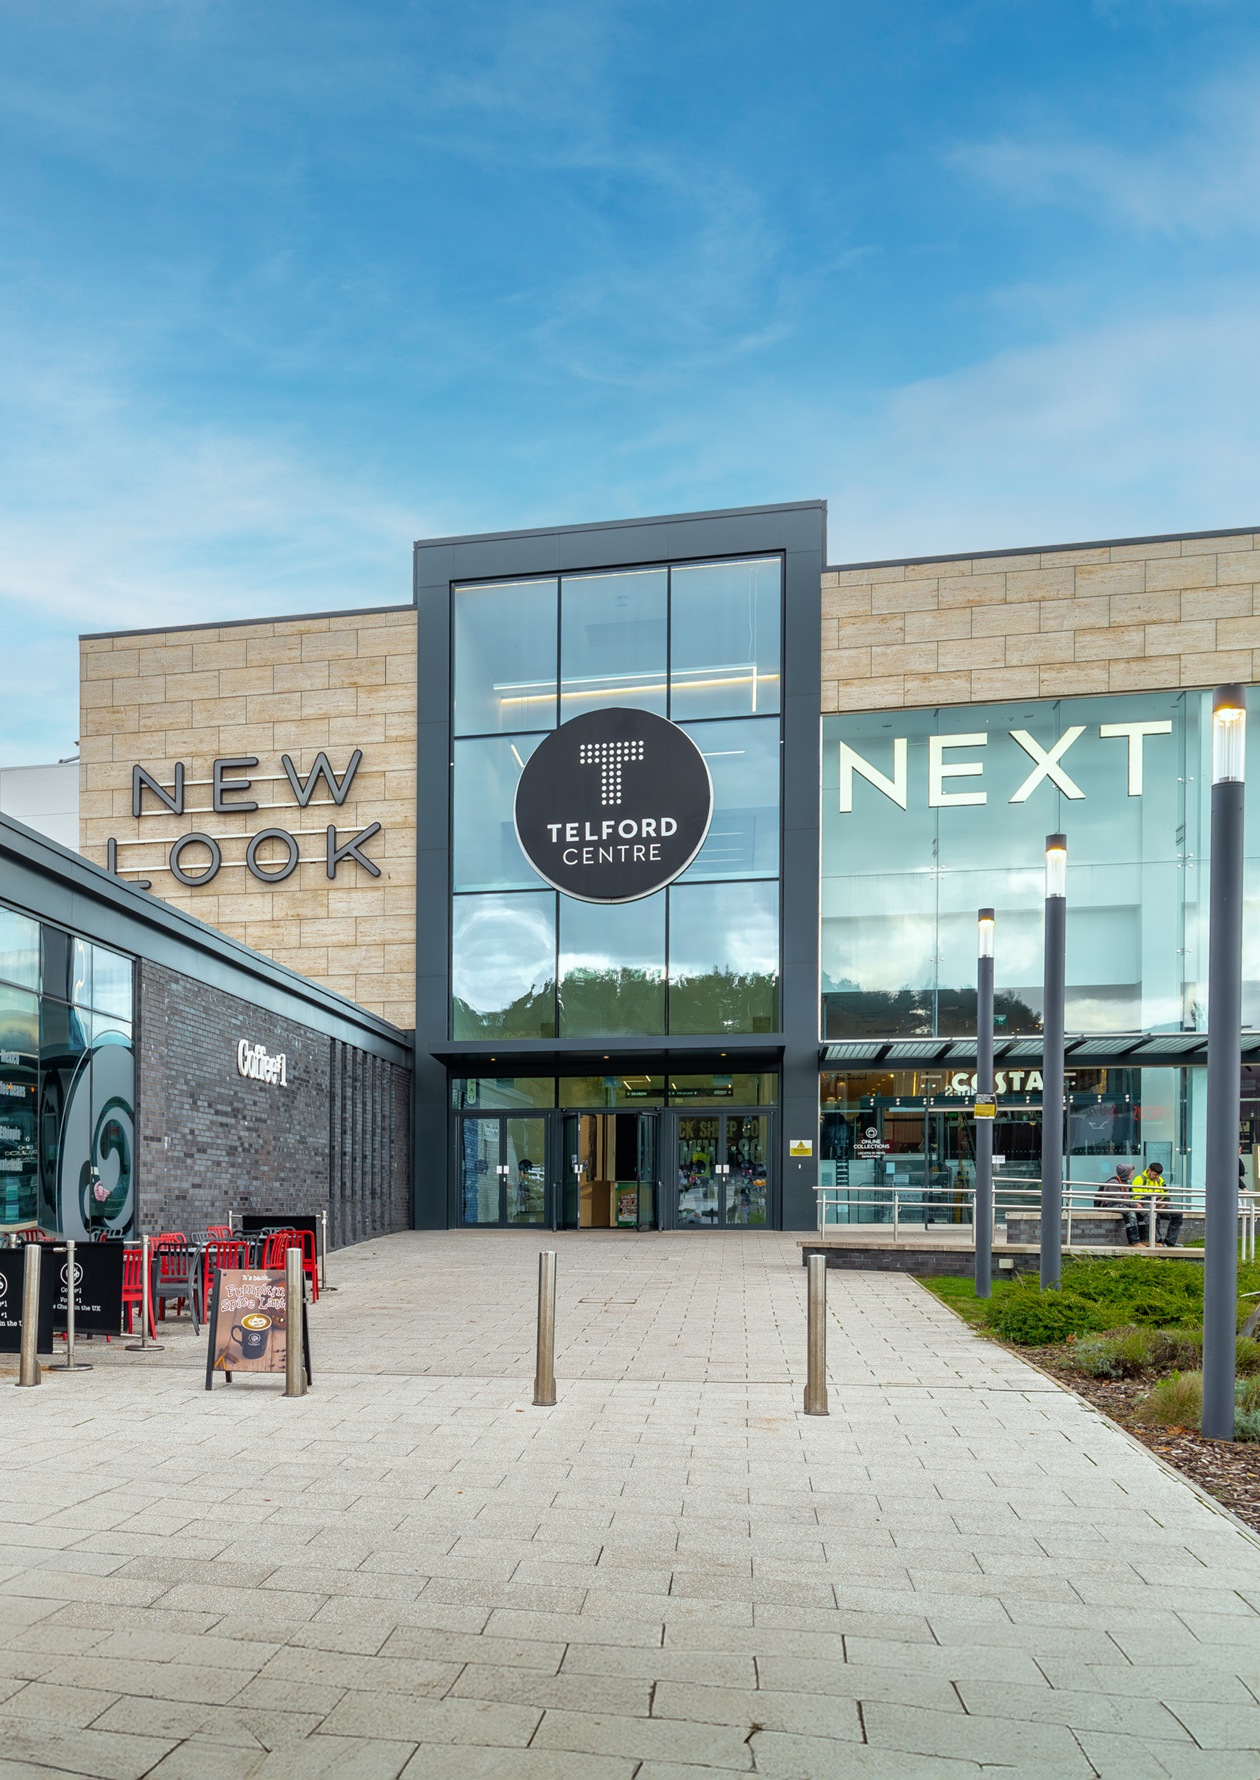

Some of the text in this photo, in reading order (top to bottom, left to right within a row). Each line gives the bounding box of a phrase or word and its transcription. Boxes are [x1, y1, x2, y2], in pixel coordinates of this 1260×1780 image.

[579, 740, 644, 806] T
[839, 720, 1172, 813] NEXT
[132, 749, 364, 818] NEW
[547, 817, 678, 843] TELFORD
[563, 843, 662, 866] CENTRE
[0, 1049, 20, 1065] Mexico
[225, 1284, 286, 1299] Pumpkin
[221, 1296, 286, 1312] Spice Latt
